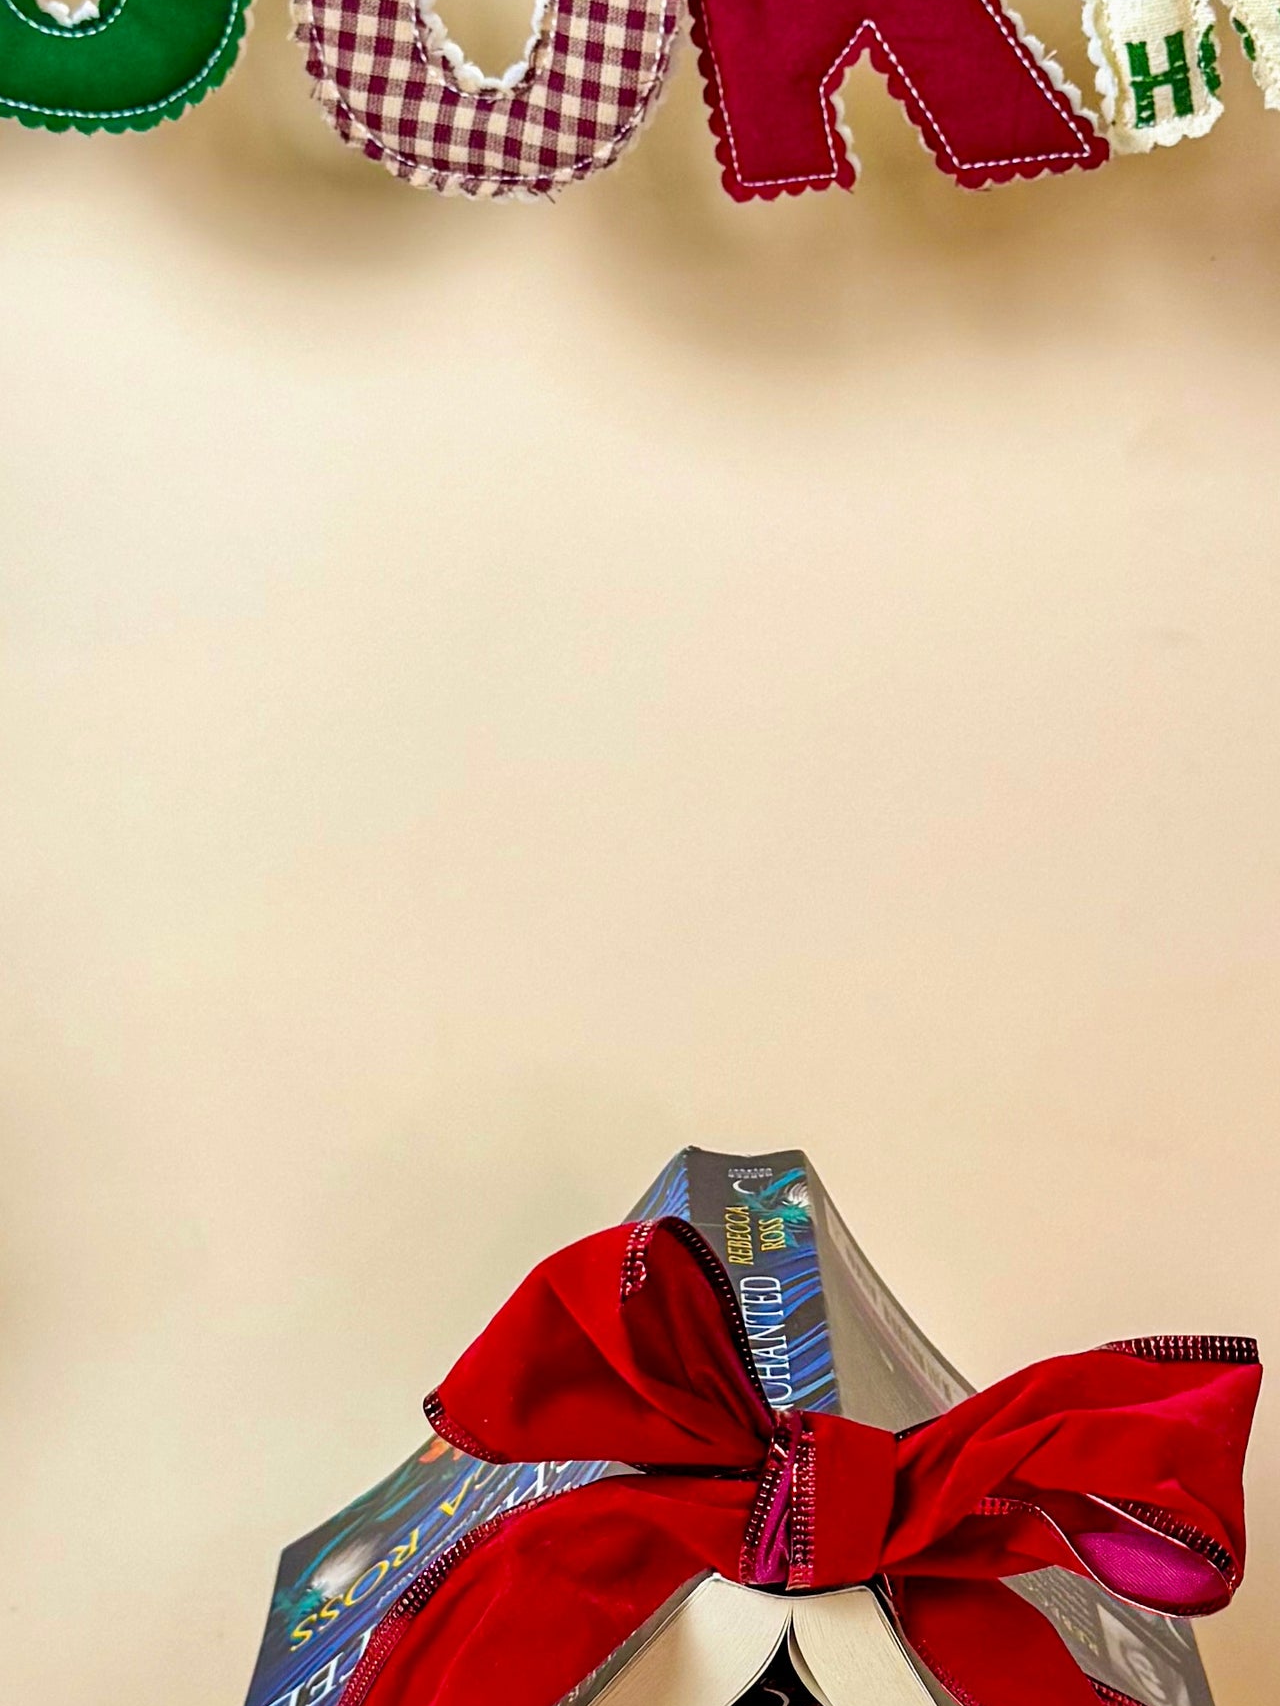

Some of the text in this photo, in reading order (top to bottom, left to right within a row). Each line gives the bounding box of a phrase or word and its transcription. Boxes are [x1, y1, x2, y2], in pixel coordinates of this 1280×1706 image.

[725, 1206, 754, 1265] REBECCA
[759, 1218, 786, 1251] ROSS
[740, 1276, 795, 1411] CHANTED
[290, 1528, 419, 1651] ROSS
